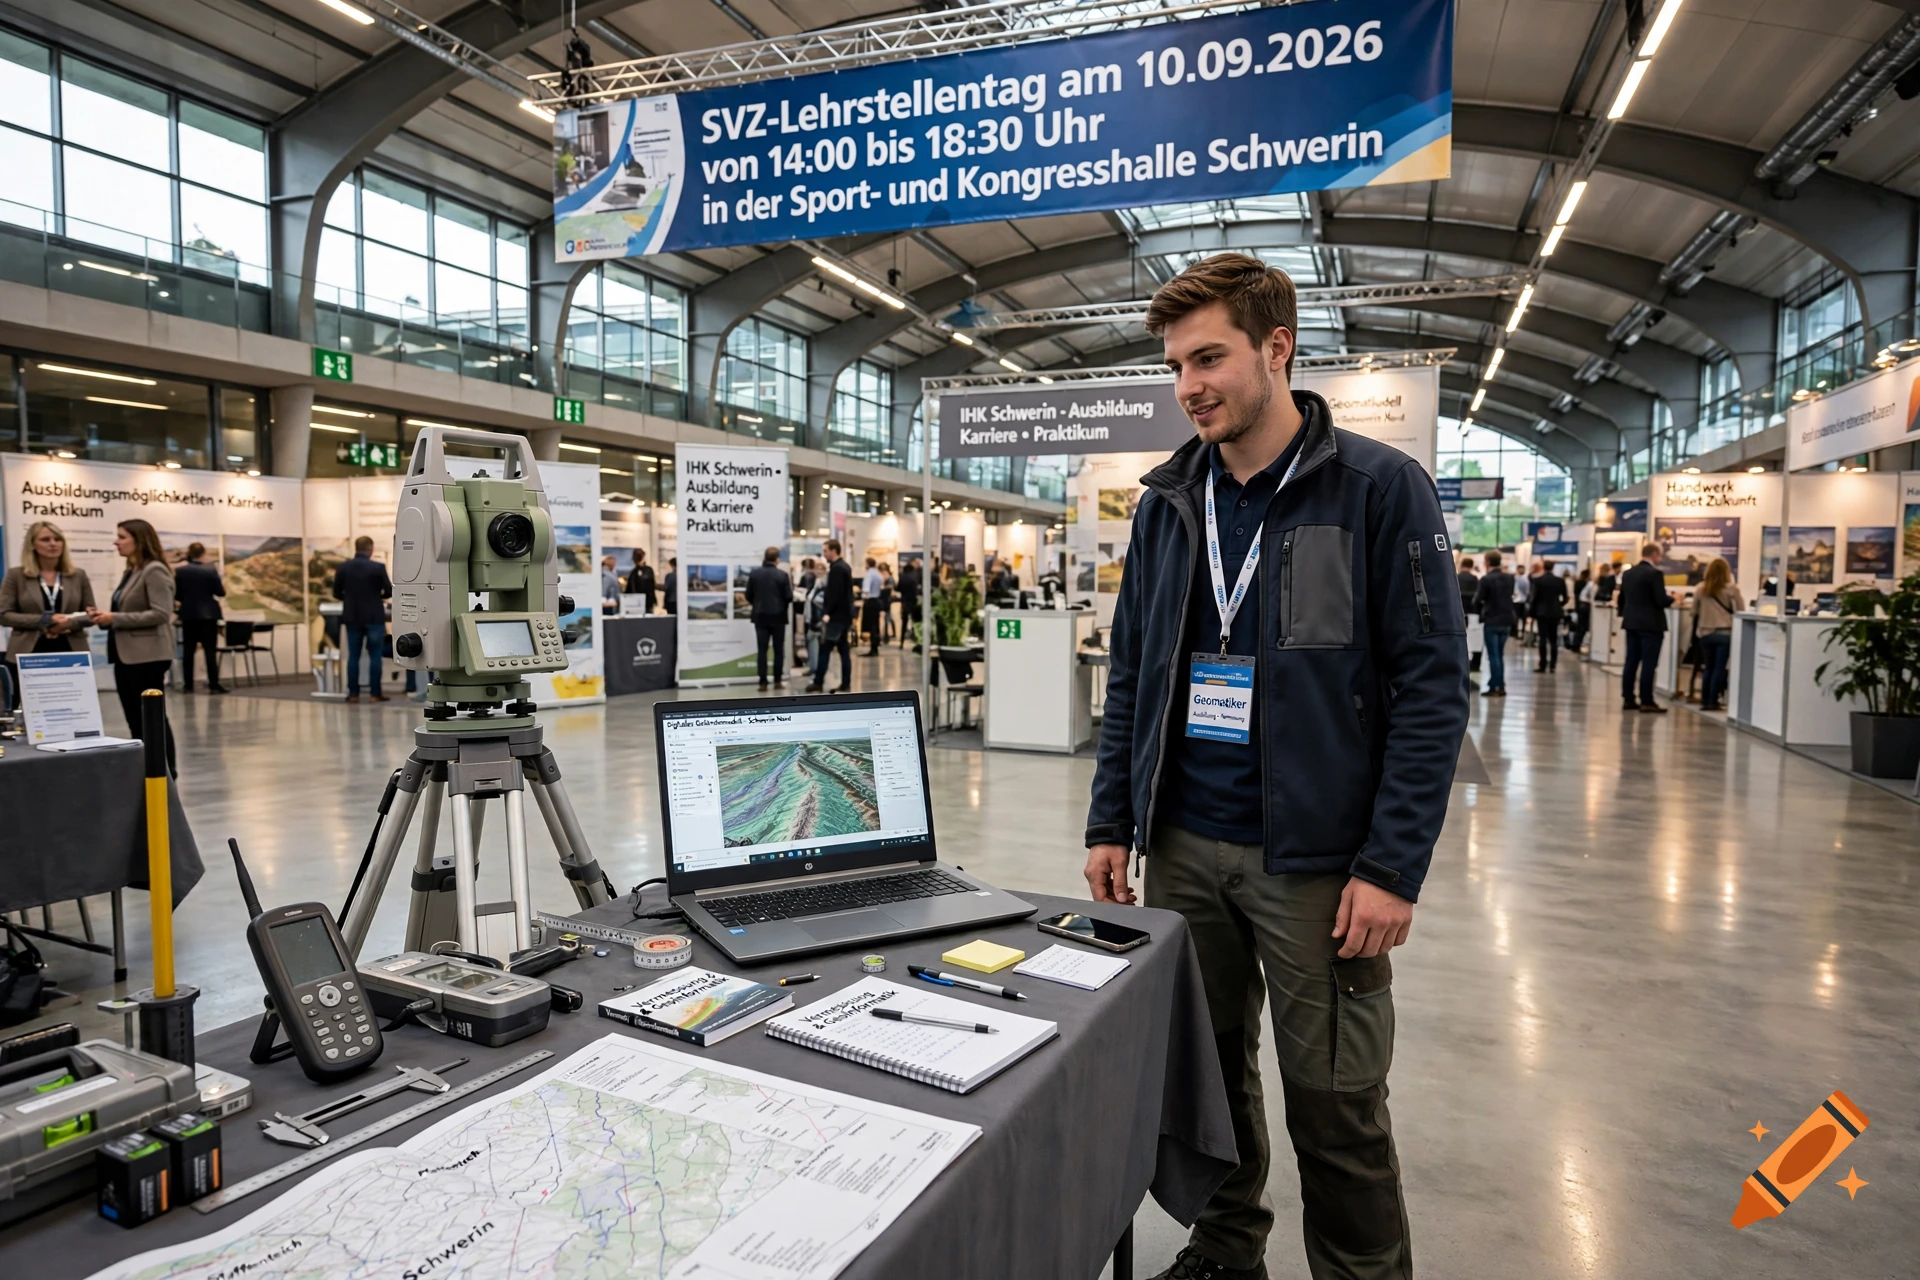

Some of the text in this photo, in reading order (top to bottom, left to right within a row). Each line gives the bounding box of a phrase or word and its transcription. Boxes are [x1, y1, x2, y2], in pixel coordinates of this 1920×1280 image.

[702, 74, 1046, 144] SVZ-Lehrstellentag
[1058, 64, 1122, 98] am
[1137, 21, 1383, 87] 10.09.2026
[702, 107, 1105, 184] von 14:00 bis 18:30 Uhr
[703, 122, 1383, 224] in der Sport- und Kongresshalle Schwerin
[960, 407, 987, 423] IHK
[991, 402, 1056, 422] Schwerin
[1068, 399, 1154, 419] Ausbildung
[960, 427, 1018, 445] Karriere
[1034, 423, 1109, 442] Praktikum
[686, 461, 710, 475] IHK
[714, 461, 773, 477] Schwerin
[686, 479, 760, 500] Ausbildung
[1667, 480, 1734, 493] Handwerk
[22, 500, 104, 518] Praktikum
[227, 494, 273, 510] Karriere
[686, 498, 754, 514] & Karriere
[1666, 494, 1757, 507] bildet Zukunft
[686, 518, 754, 533] Praktikum
[1194, 694, 1247, 709] Geomatiker
[403, 1221, 495, 1280] Schwerin
